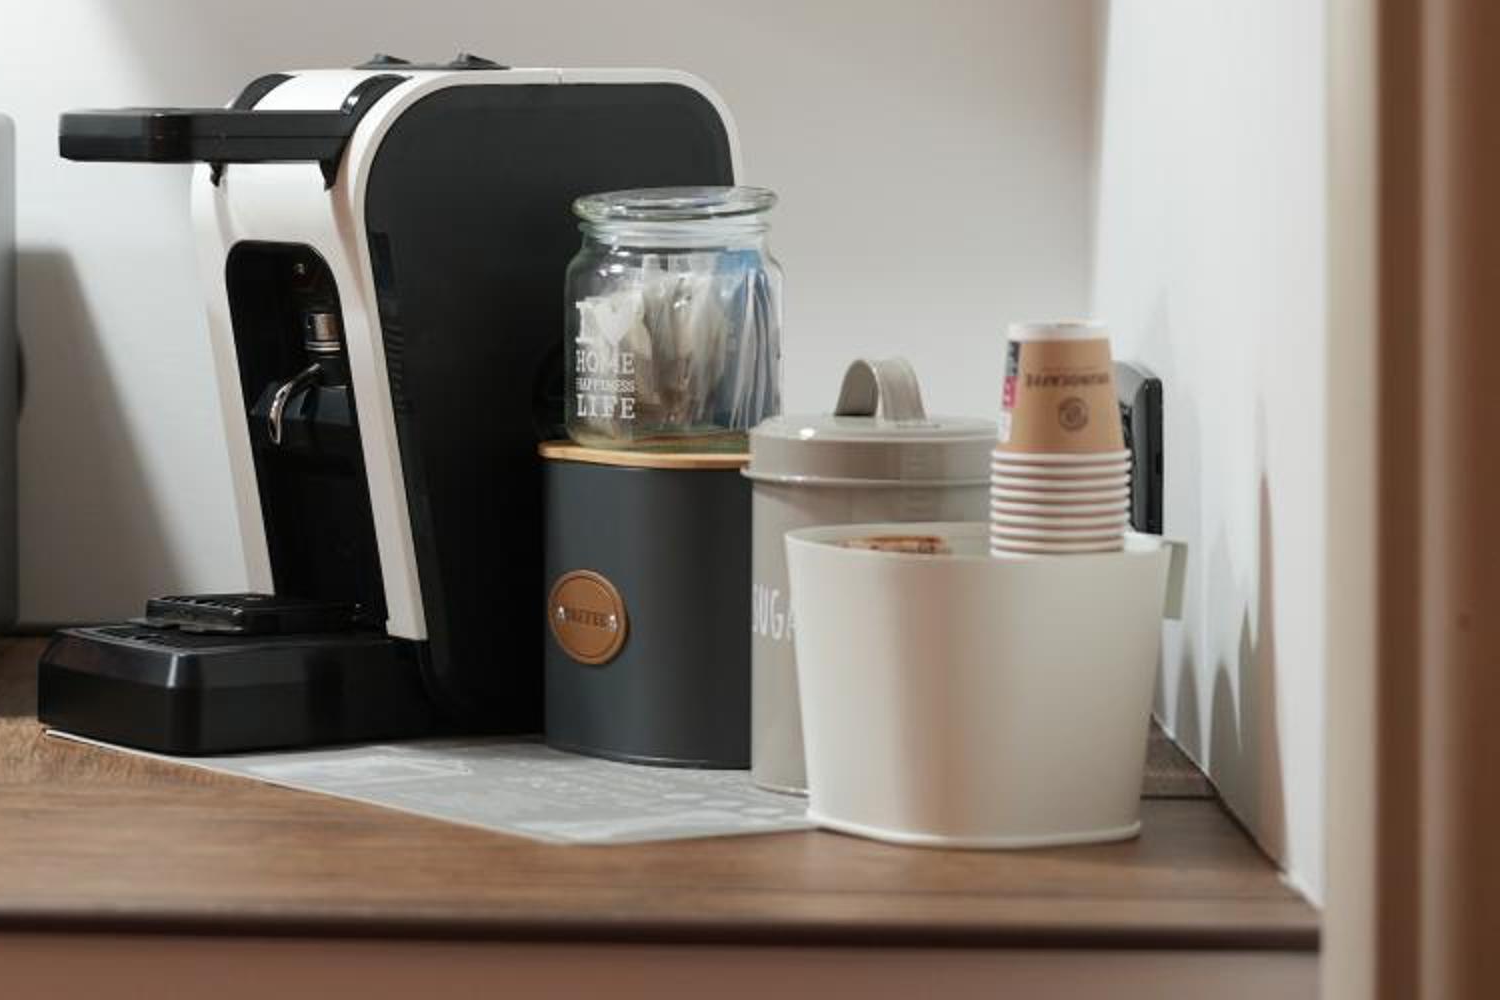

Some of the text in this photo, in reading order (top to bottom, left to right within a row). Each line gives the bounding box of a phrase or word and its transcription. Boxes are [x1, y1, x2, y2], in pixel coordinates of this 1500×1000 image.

[575, 301, 592, 343] I
[575, 350, 636, 374] HOME
[575, 394, 636, 419] LIFE
